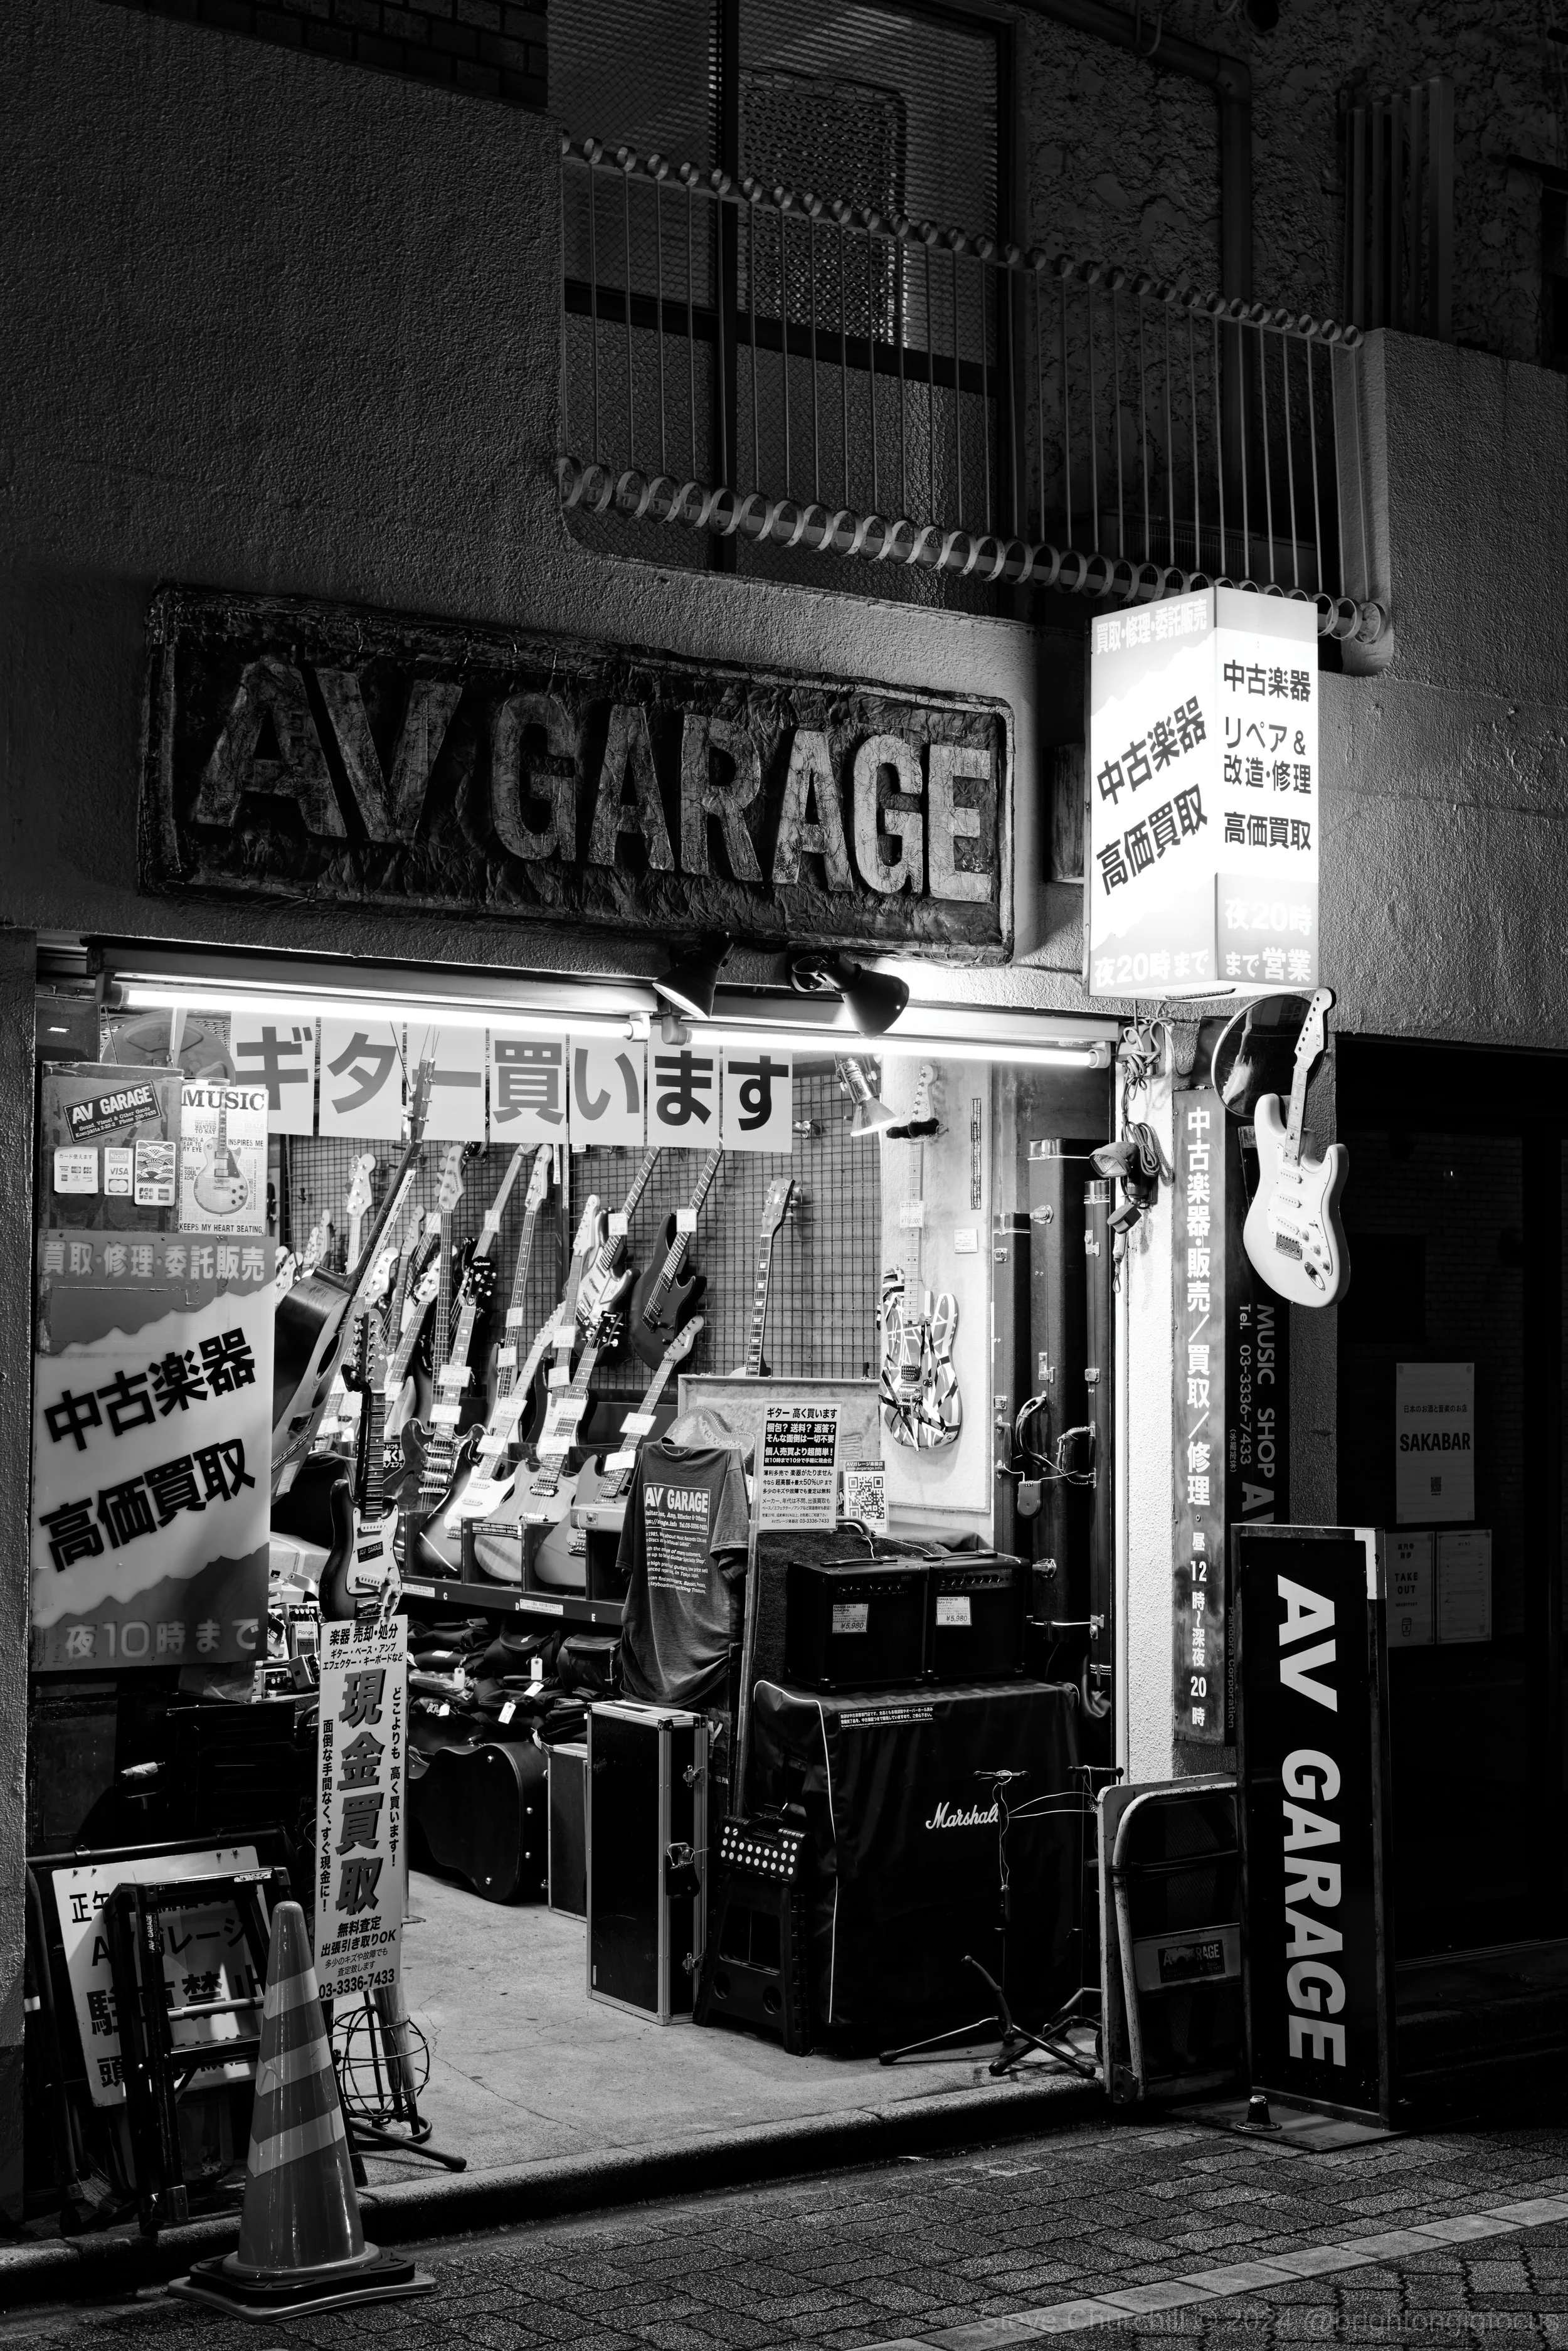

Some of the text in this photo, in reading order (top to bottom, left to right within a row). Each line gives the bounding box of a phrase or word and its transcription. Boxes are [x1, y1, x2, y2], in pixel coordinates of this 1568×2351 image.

[1224, 659, 1310, 702] 中古楽器
[1098, 696, 1207, 805] 中古楽器
[191, 654, 992, 903] AV GARAGE
[1224, 755, 1311, 795] 改造・修理
[1096, 783, 1207, 896] 高価買取
[1224, 811, 1311, 852] 高価買取
[1225, 898, 1312, 937] 夜20時
[1094, 948, 1209, 988] 夜20時まで
[1225, 947, 1311, 982] まで営業
[236, 1026, 788, 1130] ギター買います
[73, 1086, 152, 1124] AV GARAGE
[181, 1090, 265, 1110] MUSIC
[97, 1117, 113, 1126] Visual
[228, 1138, 253, 1147] INSPIRES
[110, 1167, 129, 1176] VISA
[1257, 1304, 1275, 1384] MUSIC
[44, 1327, 255, 1451] 中古楽器
[1239, 1303, 1252, 1465] Tel. 03-3336-7433
[767, 1408, 837, 1419] ギター 高く買います
[1404, 1404, 1468, 1413] 日本のお酒と音楽のお店
[766, 1434, 835, 1443] そんな面倒は一切不要
[1257, 1407, 1275, 1478] SHOP
[1400, 1433, 1470, 1451] SAKABAR
[40, 1438, 255, 1572] 高価買取
[645, 1487, 708, 1513] AV GARAGE
[1395, 1573, 1418, 1581] TAKE
[1397, 1586, 1416, 1595] OUT
[516, 1602, 519, 1610] D
[591, 1613, 596, 1621] E
[65, 1618, 258, 1657] 夜10時まで
[330, 1623, 398, 1646] 楽器 売却・処分
[335, 1668, 386, 1916] 現金買取
[1277, 1574, 1347, 2067] AV GARAGE
[146, 1915, 156, 1950] AV GARAGE
[320, 1929, 396, 1958] 出張引き取りOK
[337, 1916, 381, 1938] 無料査定
[325, 1947, 388, 1969] 多少のキズや故障でも
[337, 1960, 375, 1977] 査定致します
[319, 1968, 395, 1998] 03-3336-7433
